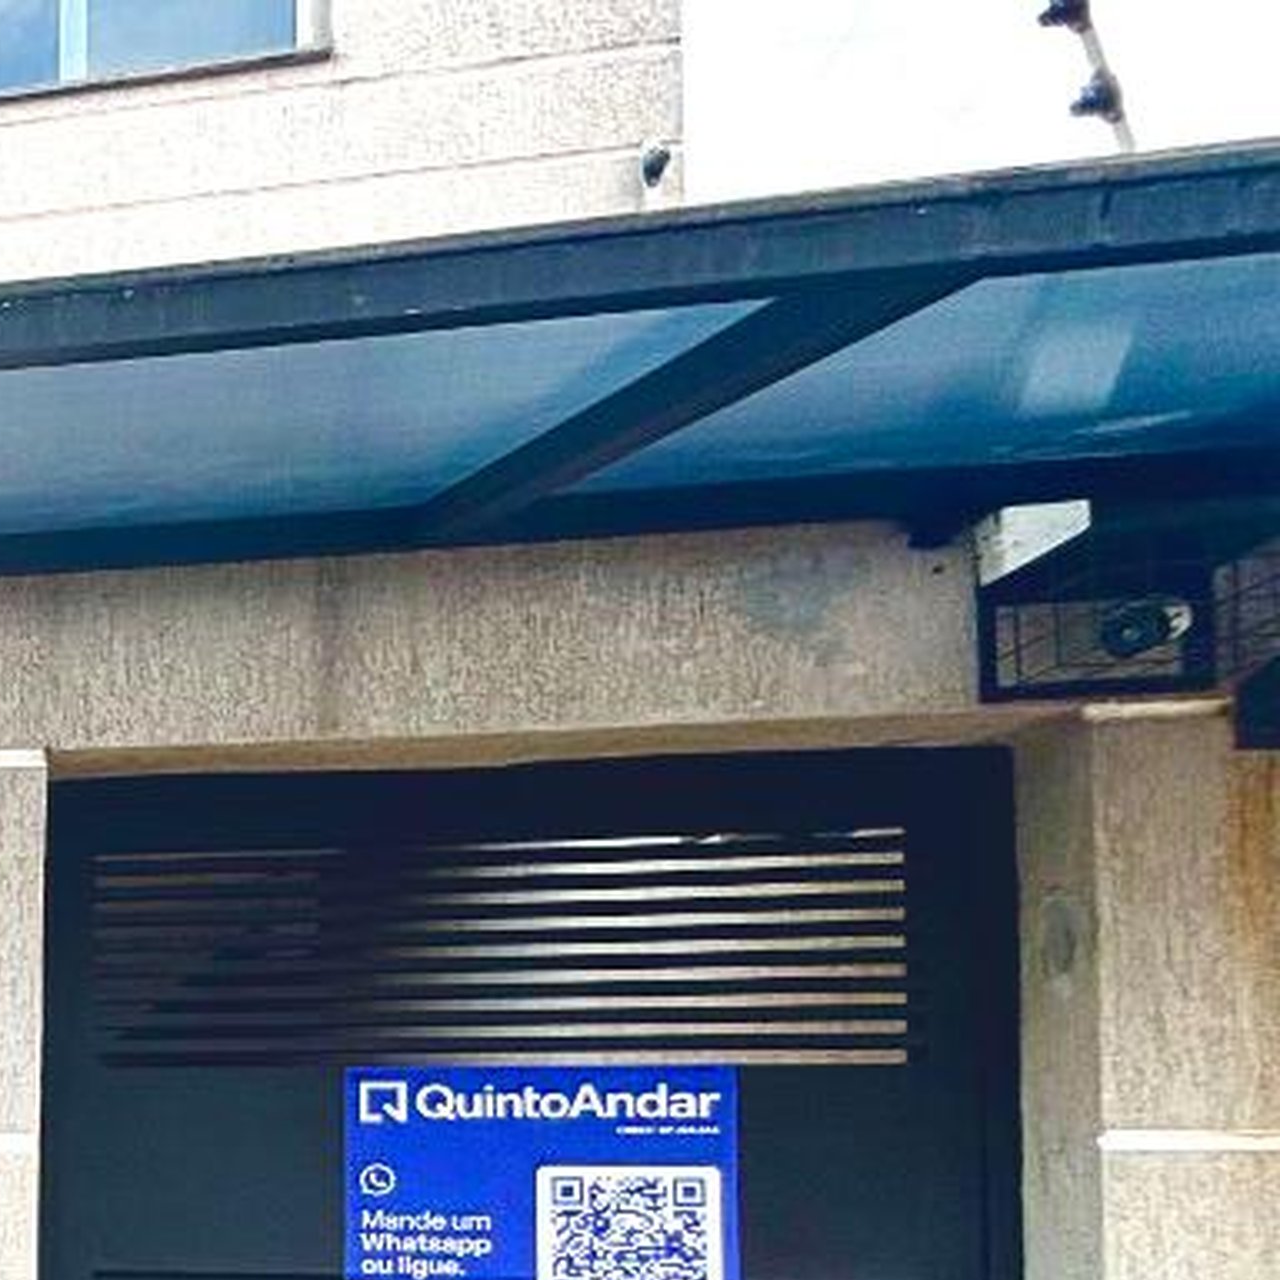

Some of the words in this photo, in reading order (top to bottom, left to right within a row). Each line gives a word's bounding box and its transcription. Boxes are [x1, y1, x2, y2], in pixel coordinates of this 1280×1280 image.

[415, 1082, 721, 1121] QuintoAndar
[361, 1209, 447, 1231] Mande
[451, 1214, 492, 1232] um
[359, 1232, 493, 1258] Whatsapp
[361, 1258, 393, 1275] ou
[397, 1256, 467, 1280] ligue.
